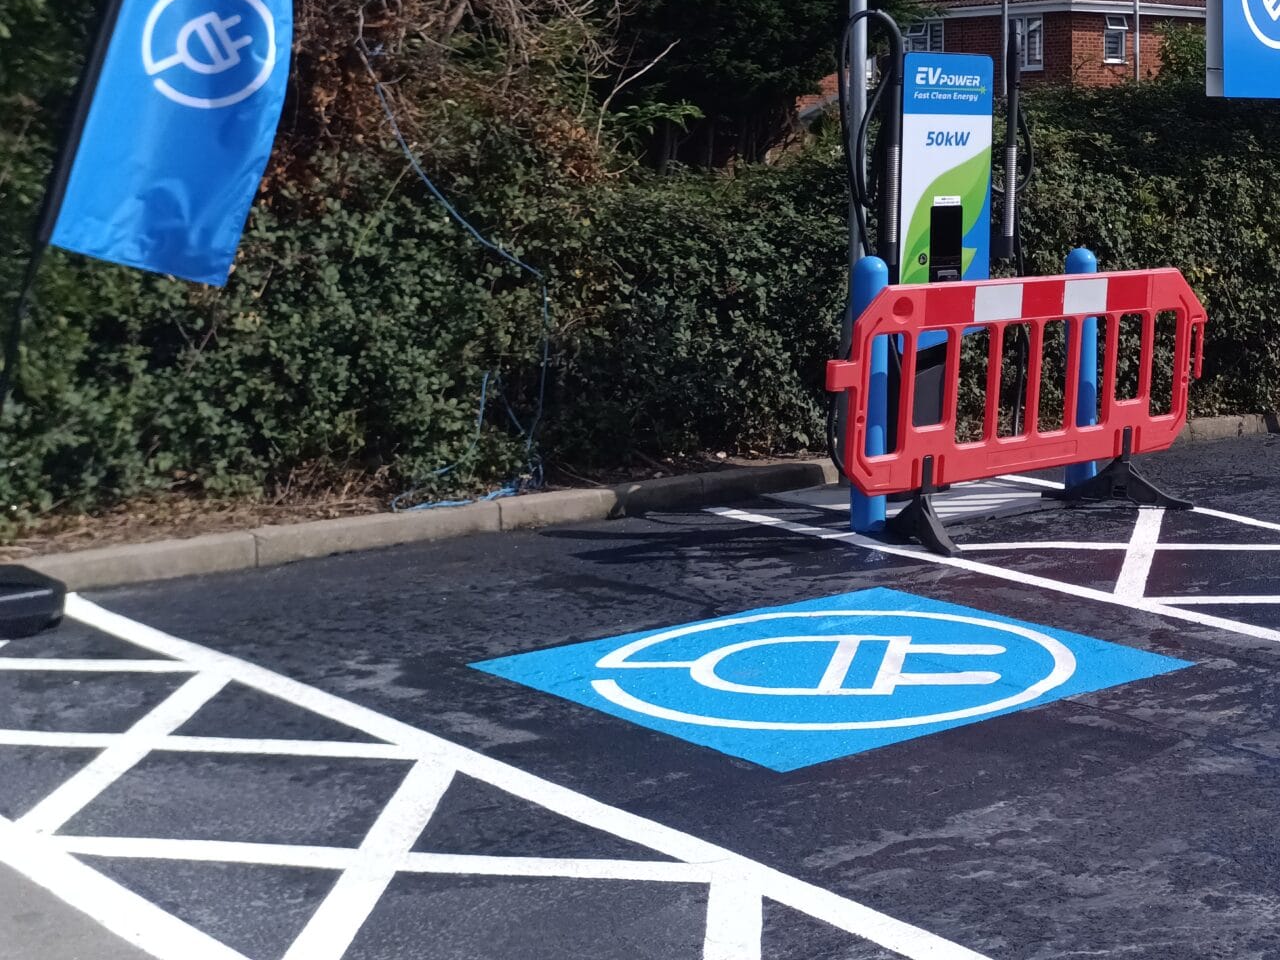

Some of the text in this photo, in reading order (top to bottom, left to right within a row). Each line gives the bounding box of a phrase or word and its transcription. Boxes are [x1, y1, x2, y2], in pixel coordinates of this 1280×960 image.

[913, 90, 979, 102] Fast Clean Energy
[925, 130, 971, 147] 50kW
